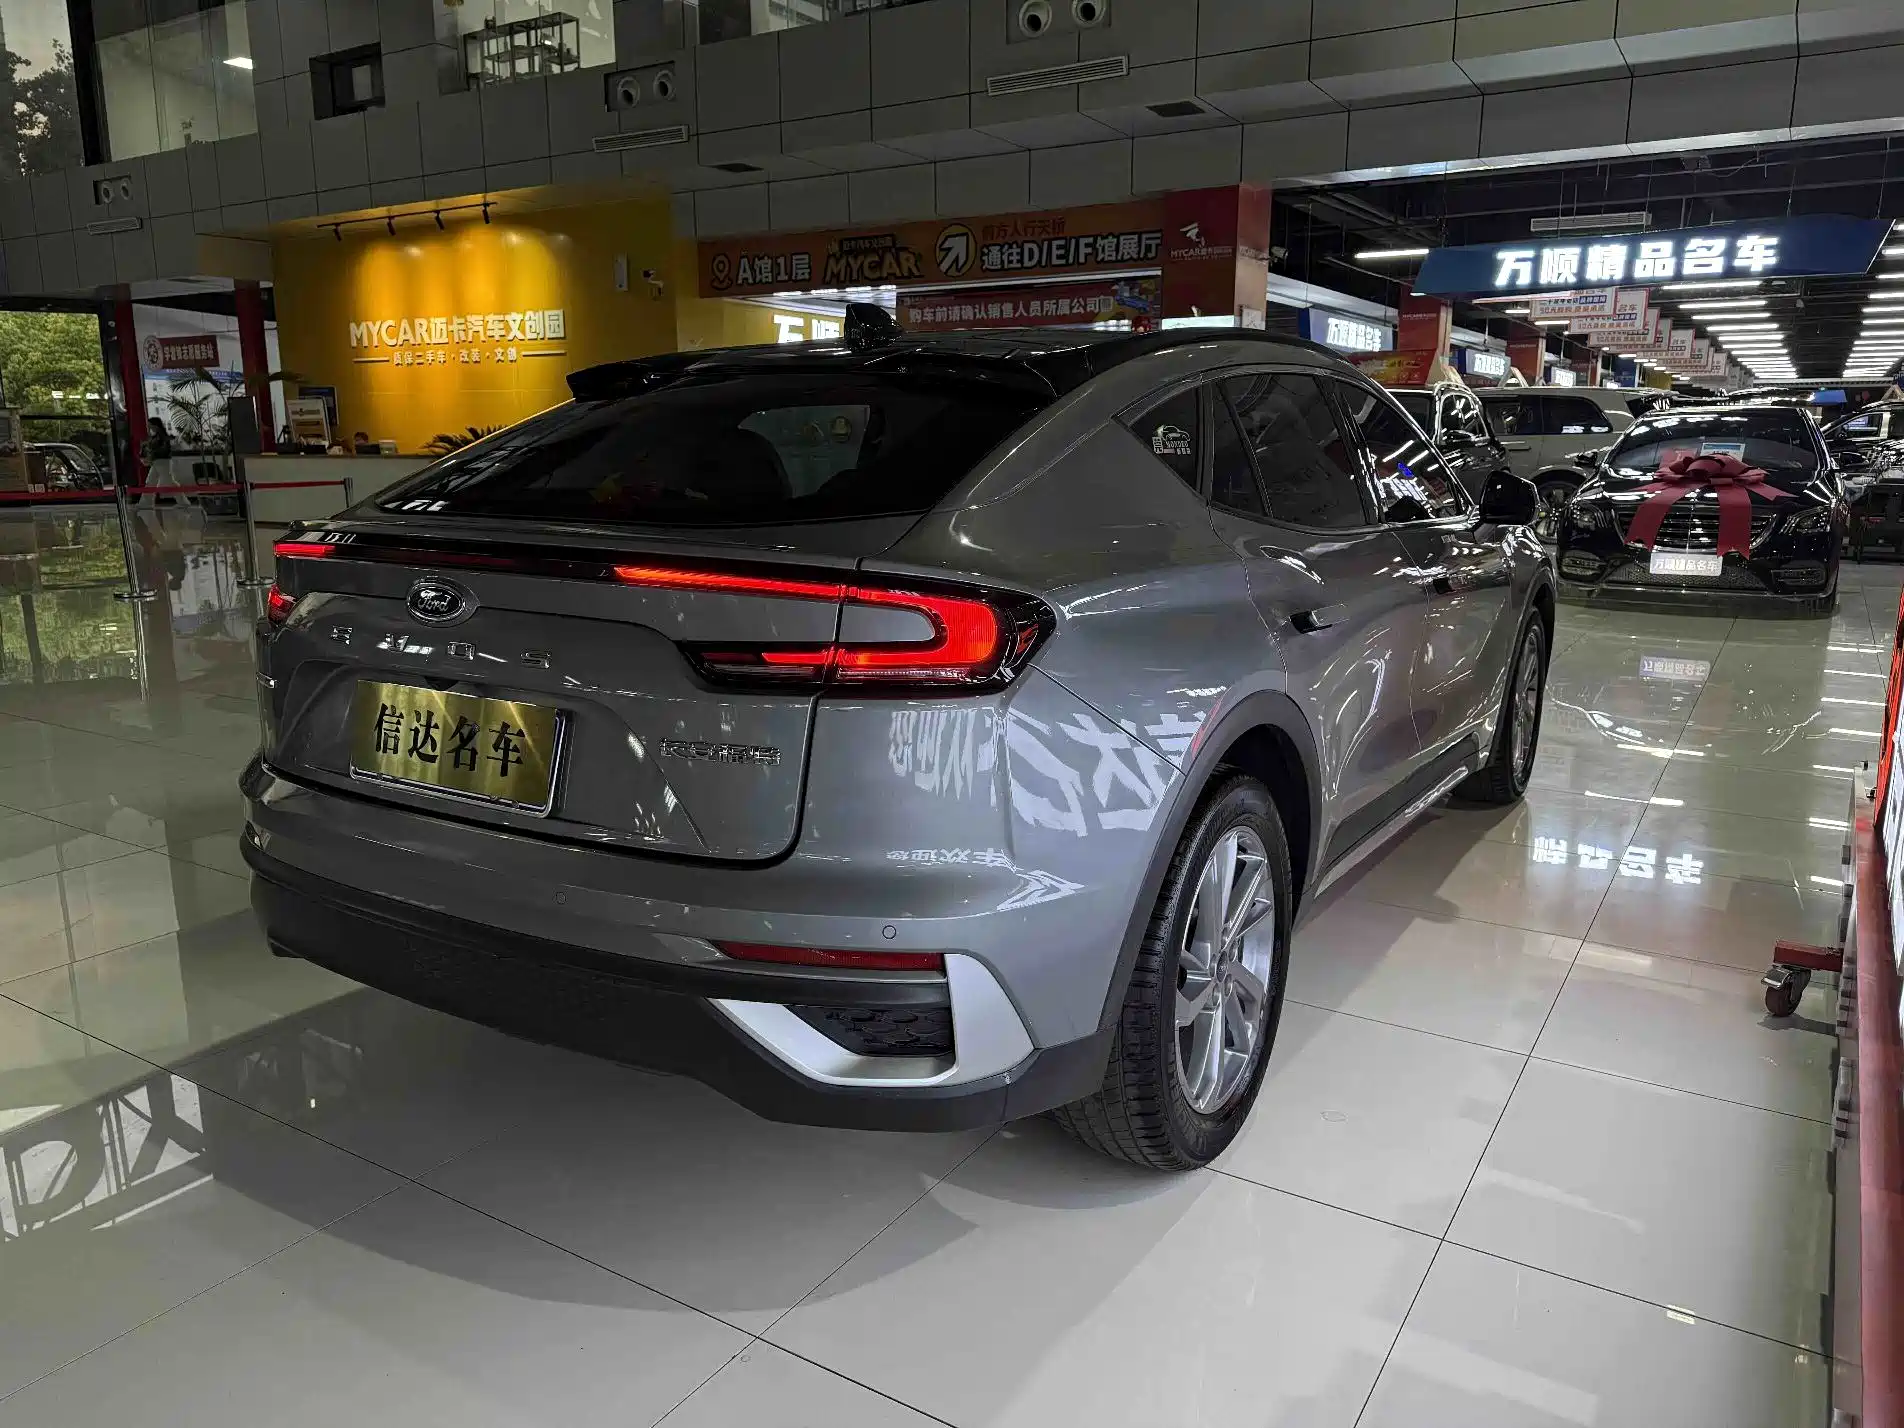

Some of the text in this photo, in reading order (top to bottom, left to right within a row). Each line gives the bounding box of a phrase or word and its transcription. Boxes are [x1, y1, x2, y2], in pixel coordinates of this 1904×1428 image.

[737, 253, 811, 285] A馆1层
[825, 249, 922, 284] MYCAR
[982, 233, 1162, 271] 通往D/E/F馆展厅
[1494, 235, 1779, 287] 万顺精品名车
[349, 308, 567, 349] MYCAR迈卡汽车文创园
[416, 589, 452, 612] Ford
[373, 701, 524, 778] 信达名车
